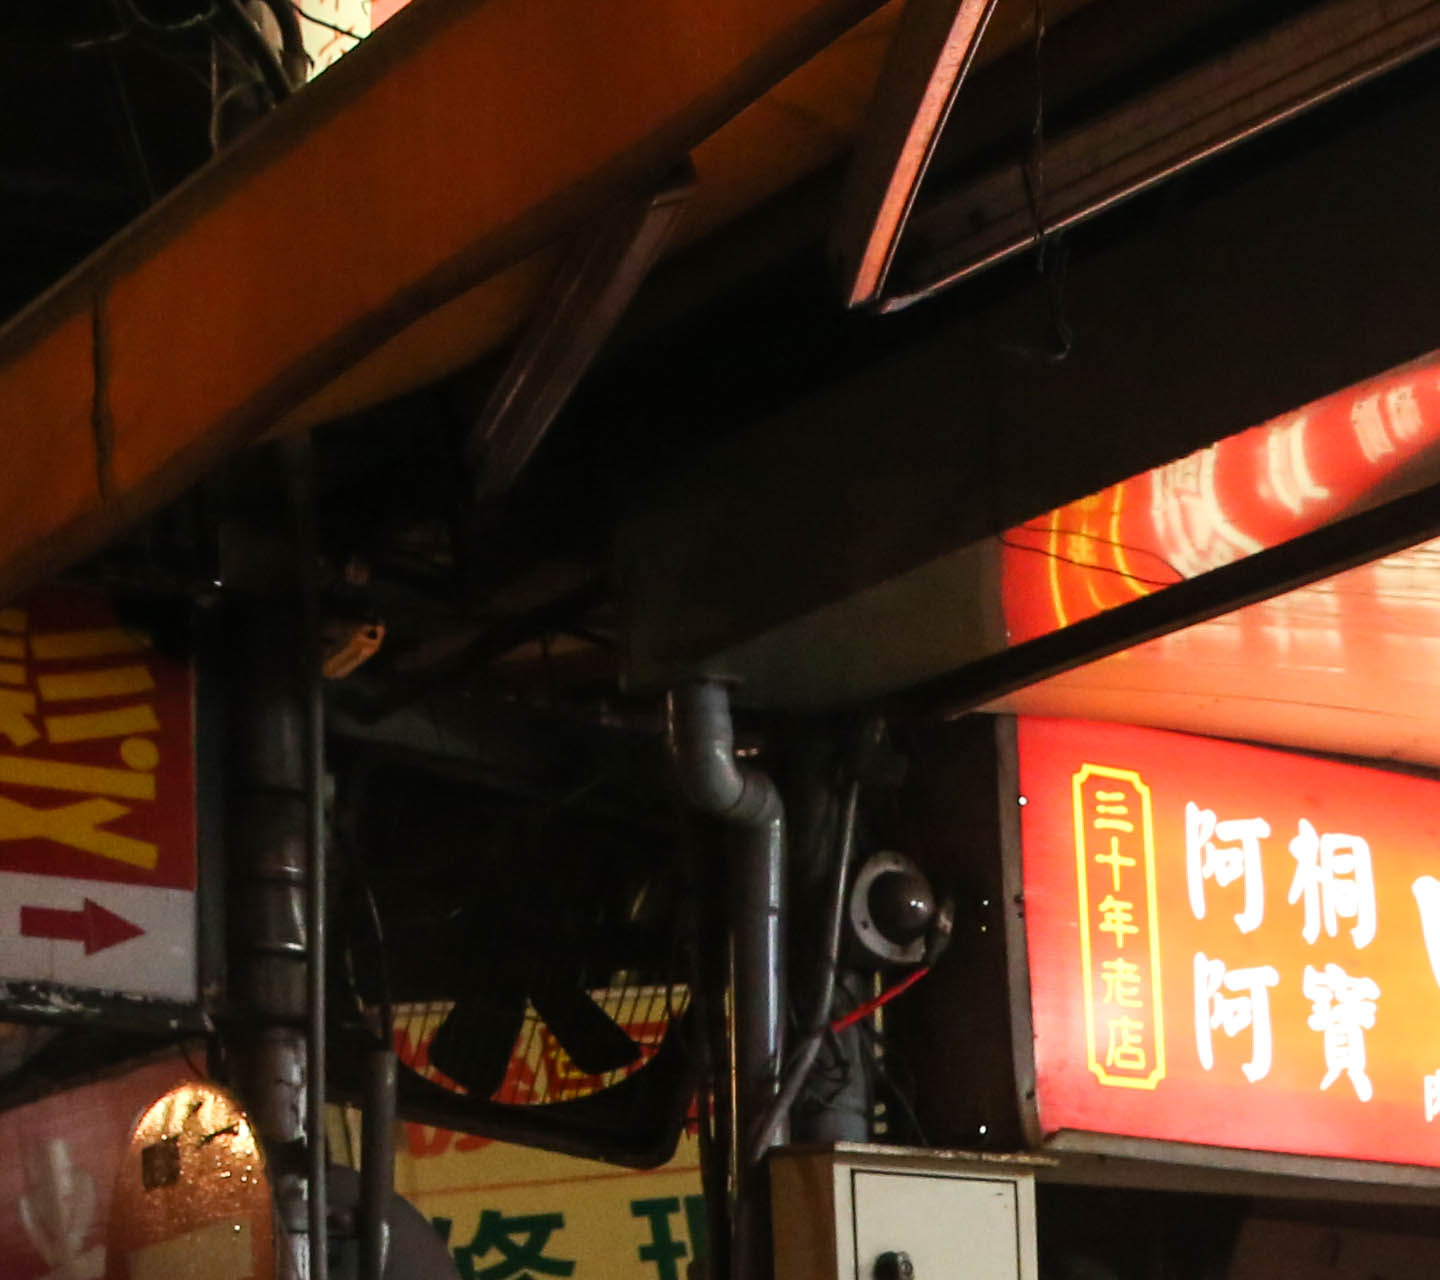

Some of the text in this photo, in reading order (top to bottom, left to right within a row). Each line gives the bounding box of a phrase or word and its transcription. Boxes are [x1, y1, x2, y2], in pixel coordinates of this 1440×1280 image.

[1093, 790, 1148, 1073] 三十年老店
[1185, 801, 1378, 950] 阿桐
[1193, 952, 1382, 1102] 阿寶
